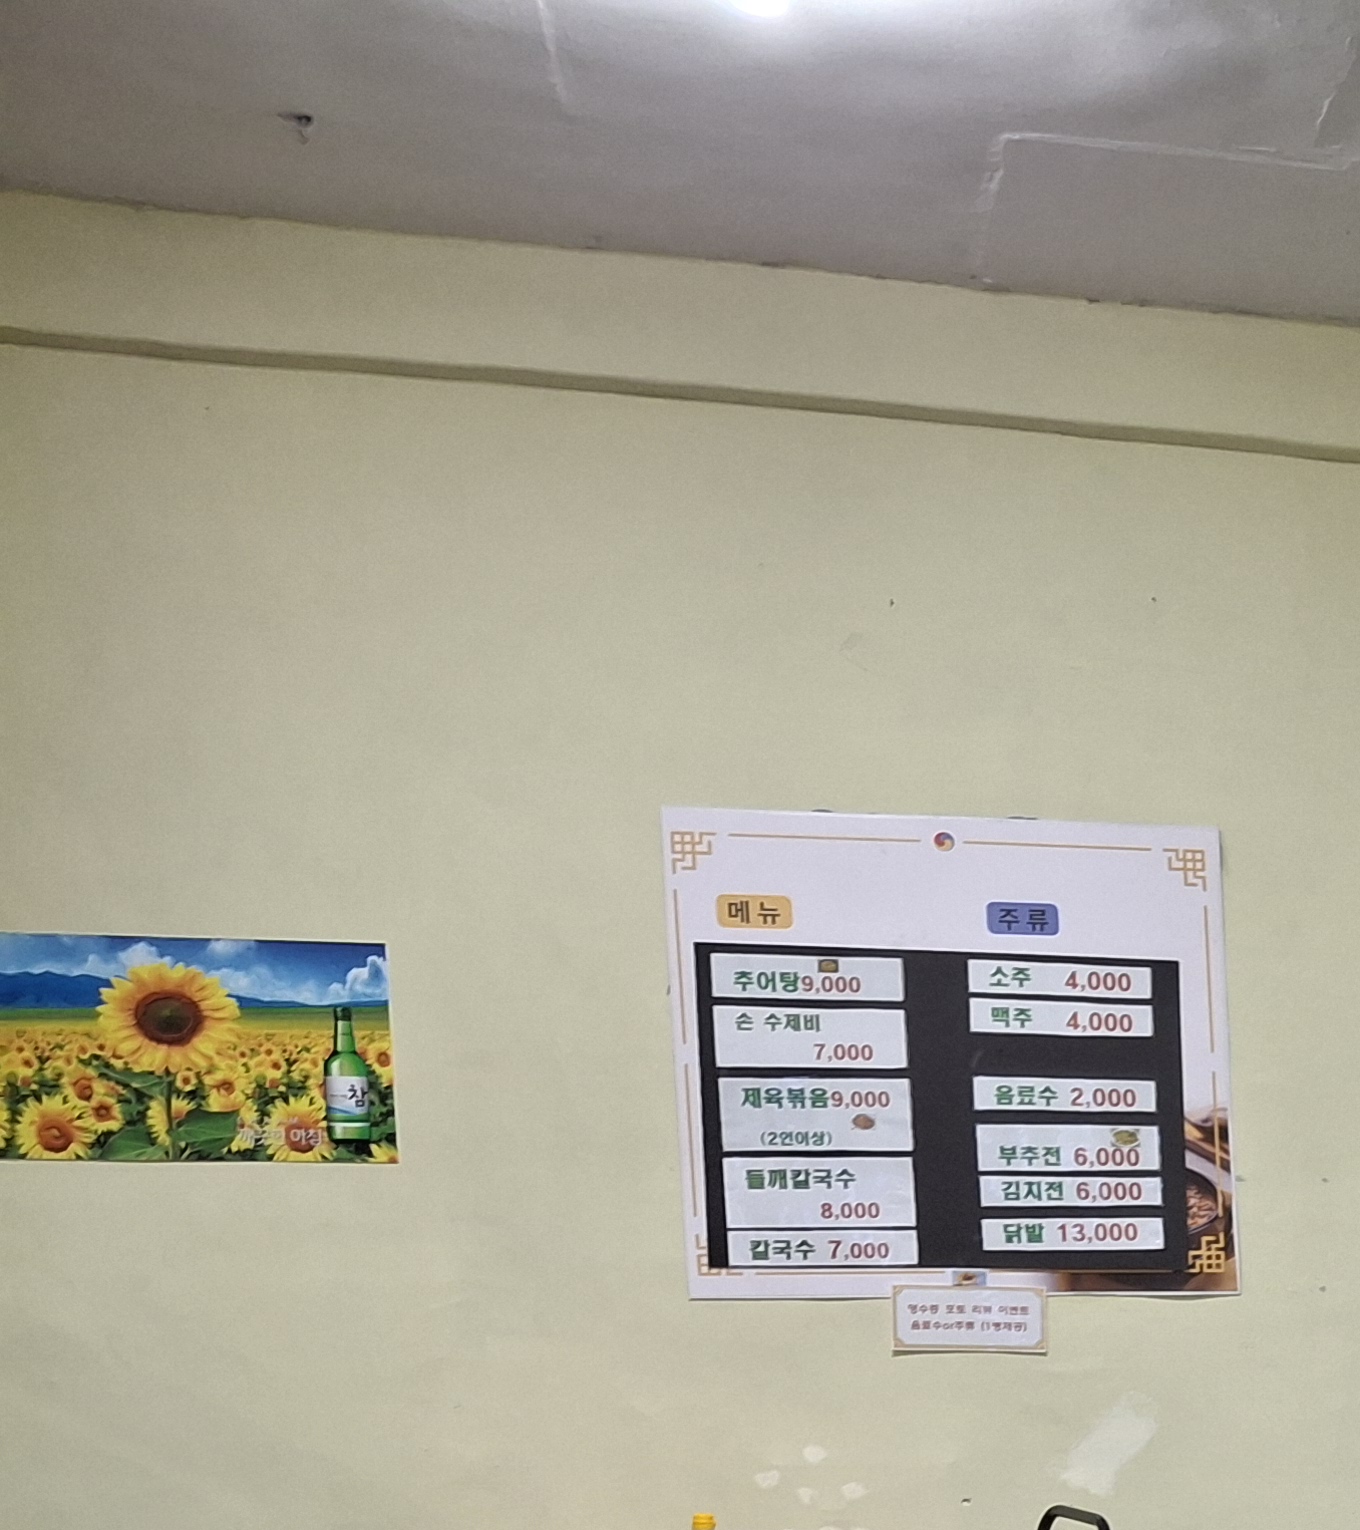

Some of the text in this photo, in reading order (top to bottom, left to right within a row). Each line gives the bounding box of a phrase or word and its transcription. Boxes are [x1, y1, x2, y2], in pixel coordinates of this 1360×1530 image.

[728, 900, 781, 925] 메뉴
[998, 908, 1049, 932] 주류
[989, 966, 1131, 991] 소주 4,000
[735, 1013, 821, 1032] 손 수제비
[991, 1007, 1132, 1032] 맥주 4,000
[813, 1043, 873, 1062] 7,000
[347, 1084, 368, 1108] 참
[995, 1085, 1136, 1108] 음료수 2,000
[998, 1146, 1140, 1168] 부추전 6,000
[745, 1169, 856, 1190] 들깨칼국수
[1001, 1181, 1142, 1203] 김치전 6,000
[820, 1202, 880, 1220] 8,000
[1003, 1223, 1137, 1244] 닭발 13,000
[749, 1240, 889, 1260] 칼국수 7,000
